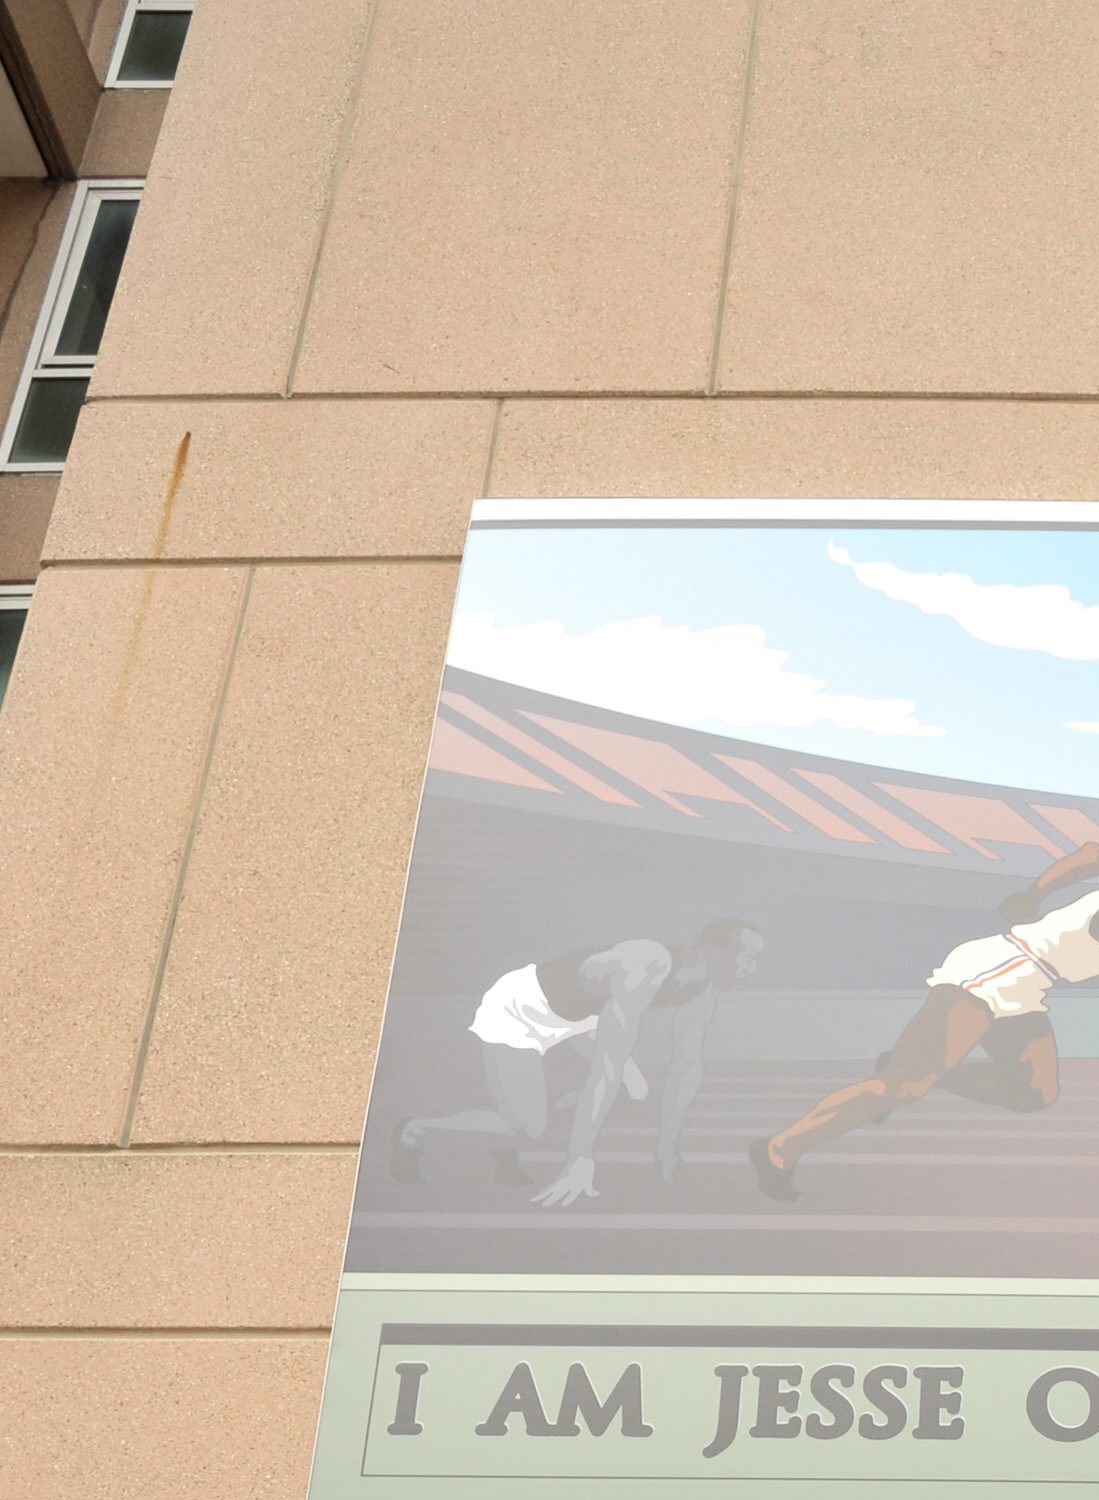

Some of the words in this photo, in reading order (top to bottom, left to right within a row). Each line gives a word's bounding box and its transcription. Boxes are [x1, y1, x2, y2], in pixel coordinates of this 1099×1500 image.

[387, 1360, 429, 1436] I
[475, 1361, 654, 1438] AM
[701, 1363, 966, 1458] JESSE
